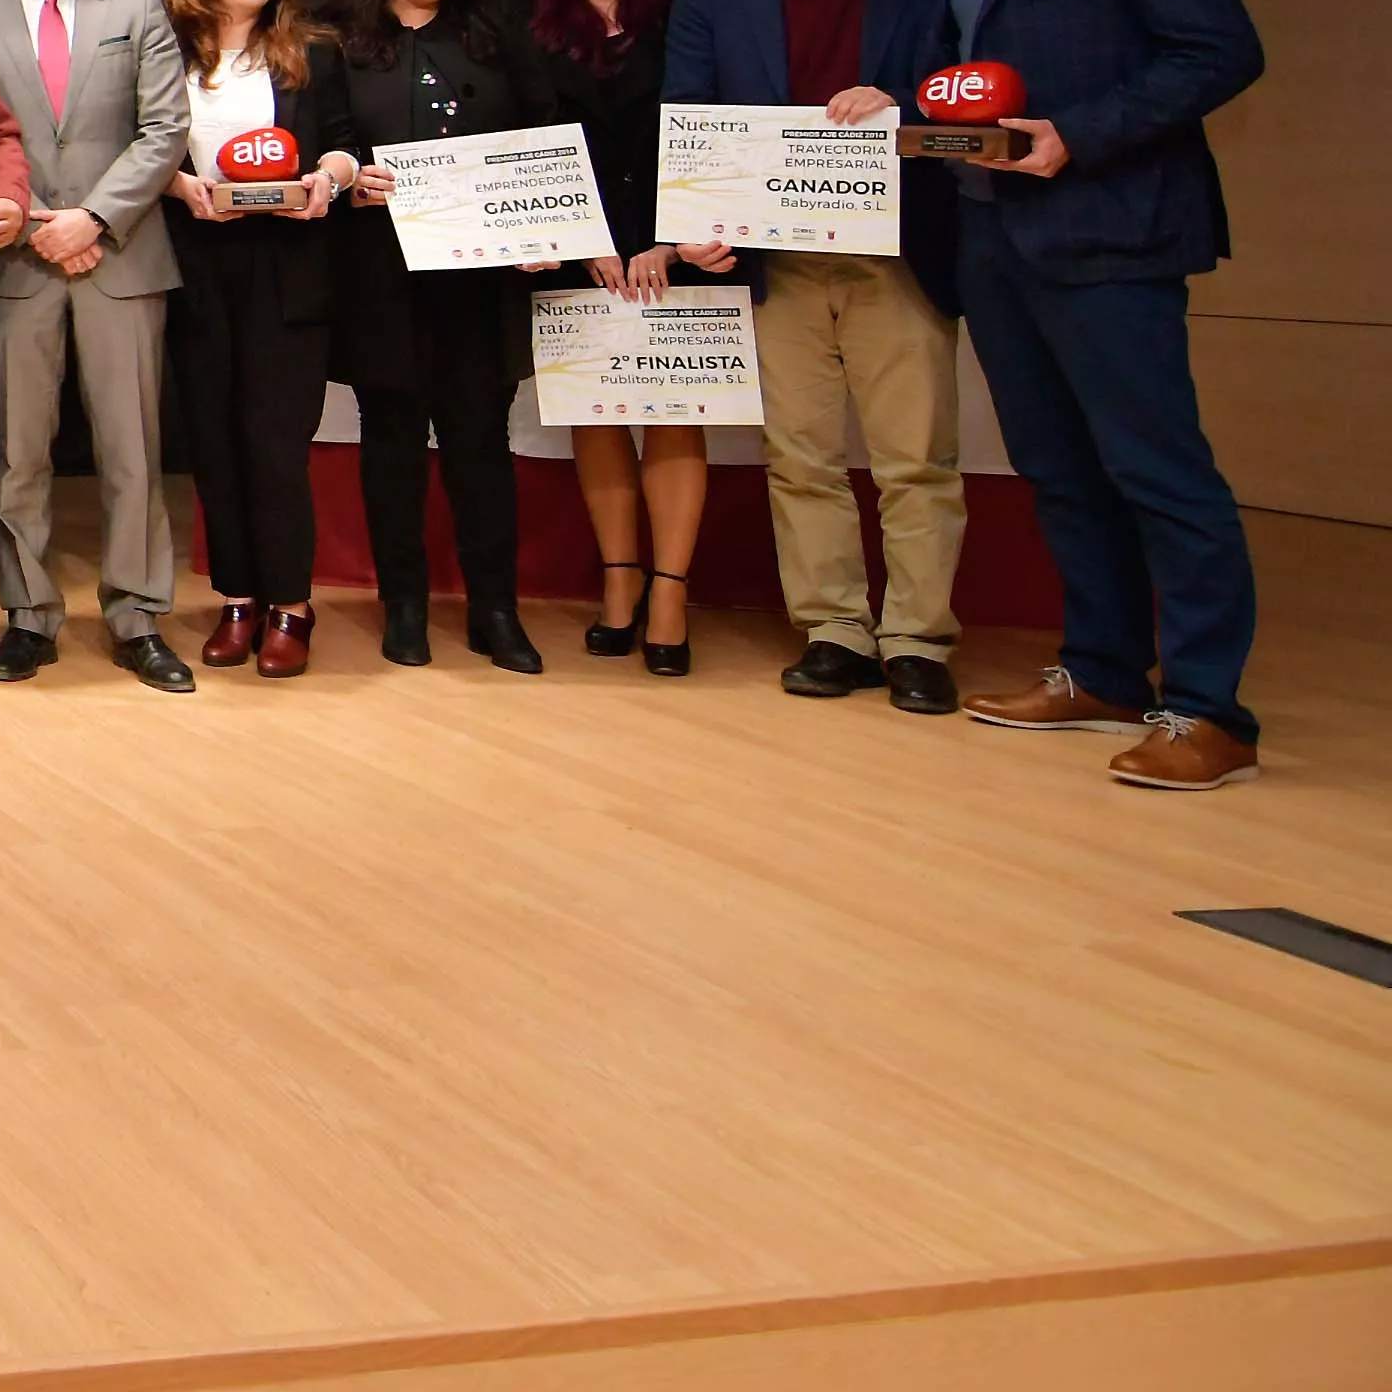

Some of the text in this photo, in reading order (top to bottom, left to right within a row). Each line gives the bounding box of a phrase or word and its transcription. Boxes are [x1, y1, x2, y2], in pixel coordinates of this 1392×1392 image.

[926, 71, 984, 105] aje
[668, 116, 750, 133] Nuestra
[783, 130, 820, 138] PREMIOS
[821, 130, 837, 138] AJE
[838, 130, 863, 139] CÁDIZ
[233, 135, 284, 166] aje
[668, 136, 712, 150] raíz.
[788, 144, 887, 155] TRAYECTORIA
[384, 153, 457, 171] Nuestra
[514, 160, 581, 176] INICIATIVA
[785, 158, 887, 169] EMPRESARIAL
[396, 173, 429, 188] aíz.
[475, 174, 584, 193] EMPRENDEDORA
[766, 178, 887, 196] GANADOR
[484, 193, 589, 215] GANADOR
[780, 198, 857, 211] Babyradio,
[484, 220, 492, 228] 4
[495, 218, 523, 229] Ojos
[536, 302, 612, 317] Nuestra
[538, 320, 579, 335] raíz.
[648, 322, 742, 332] TRAYECTORIA
[649, 336, 743, 346] EMPRESARIAL
[637, 356, 746, 370] FINALISTA
[600, 374, 665, 386] Publitony
[670, 374, 722, 386] España,
